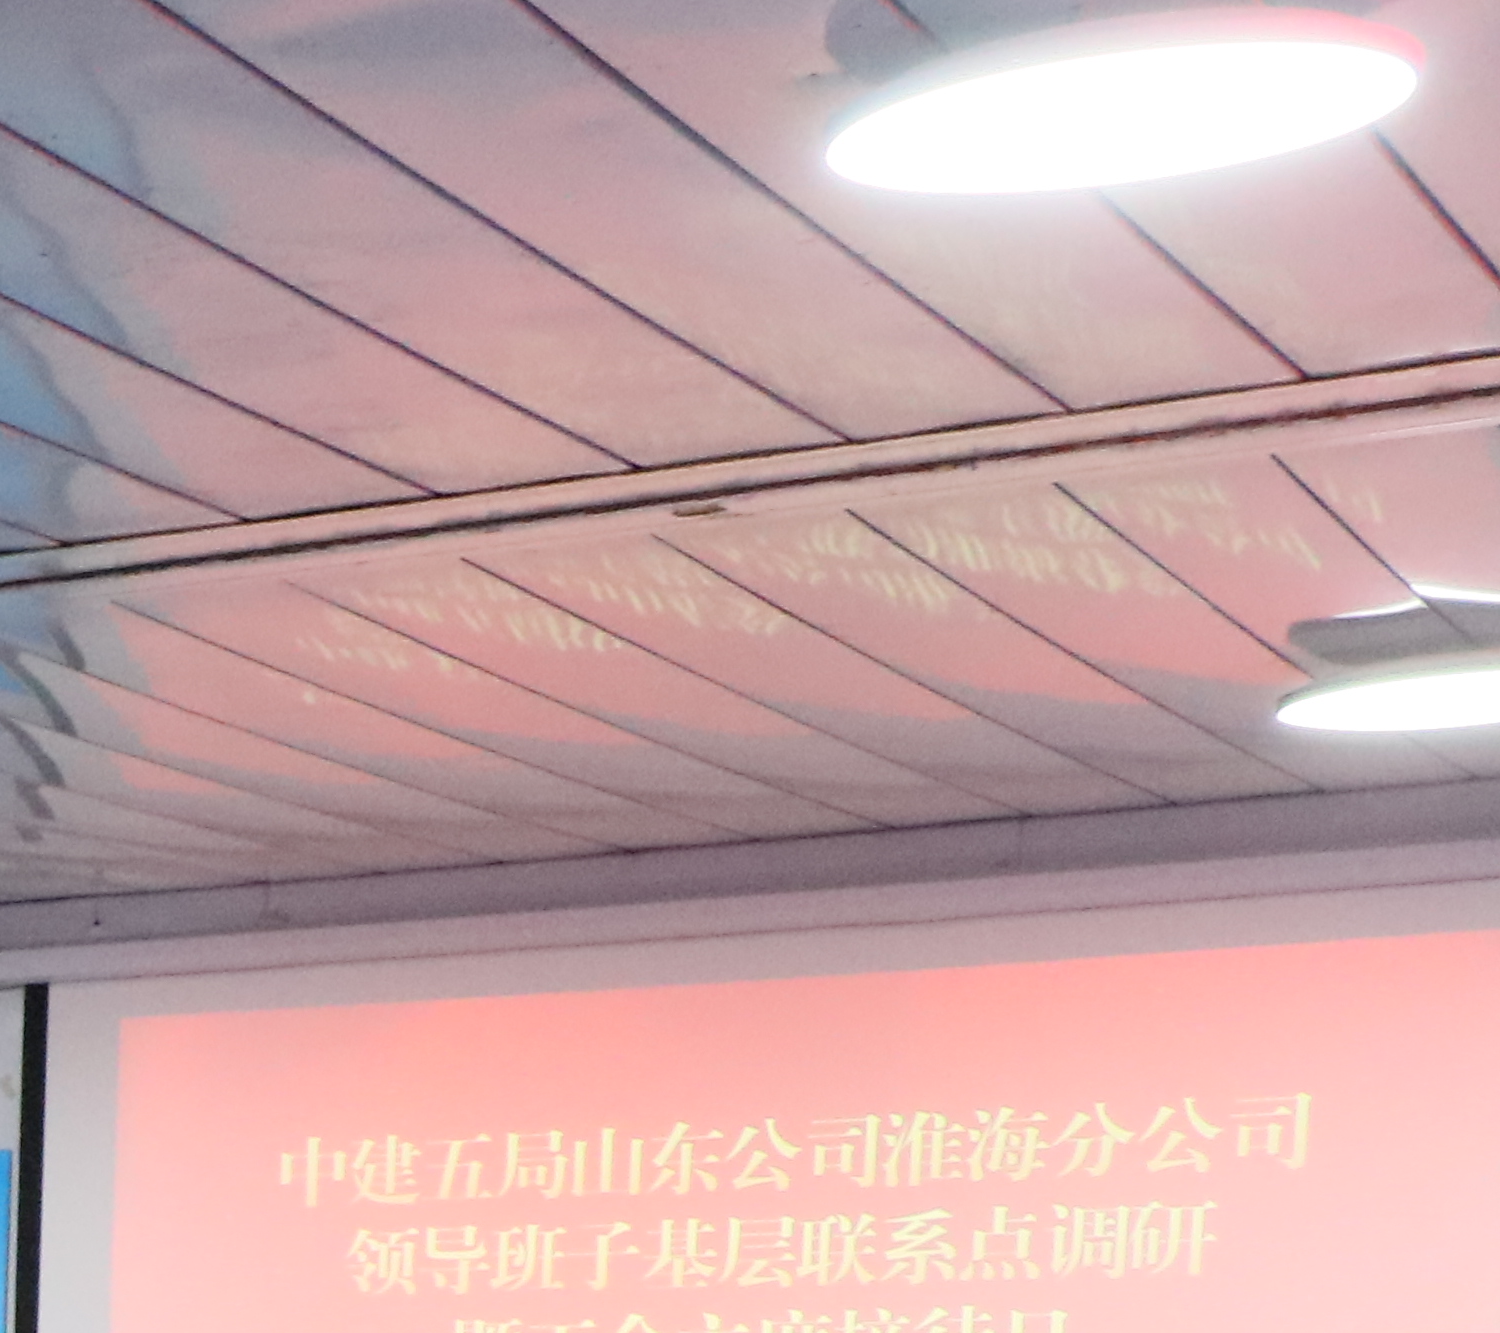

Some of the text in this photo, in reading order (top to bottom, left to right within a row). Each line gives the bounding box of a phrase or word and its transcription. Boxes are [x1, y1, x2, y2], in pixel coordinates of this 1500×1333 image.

[278, 1090, 1314, 1210] 中建五局山东公司淮海分公司
[346, 1199, 1219, 1297] 领导班子基层联系点调研
